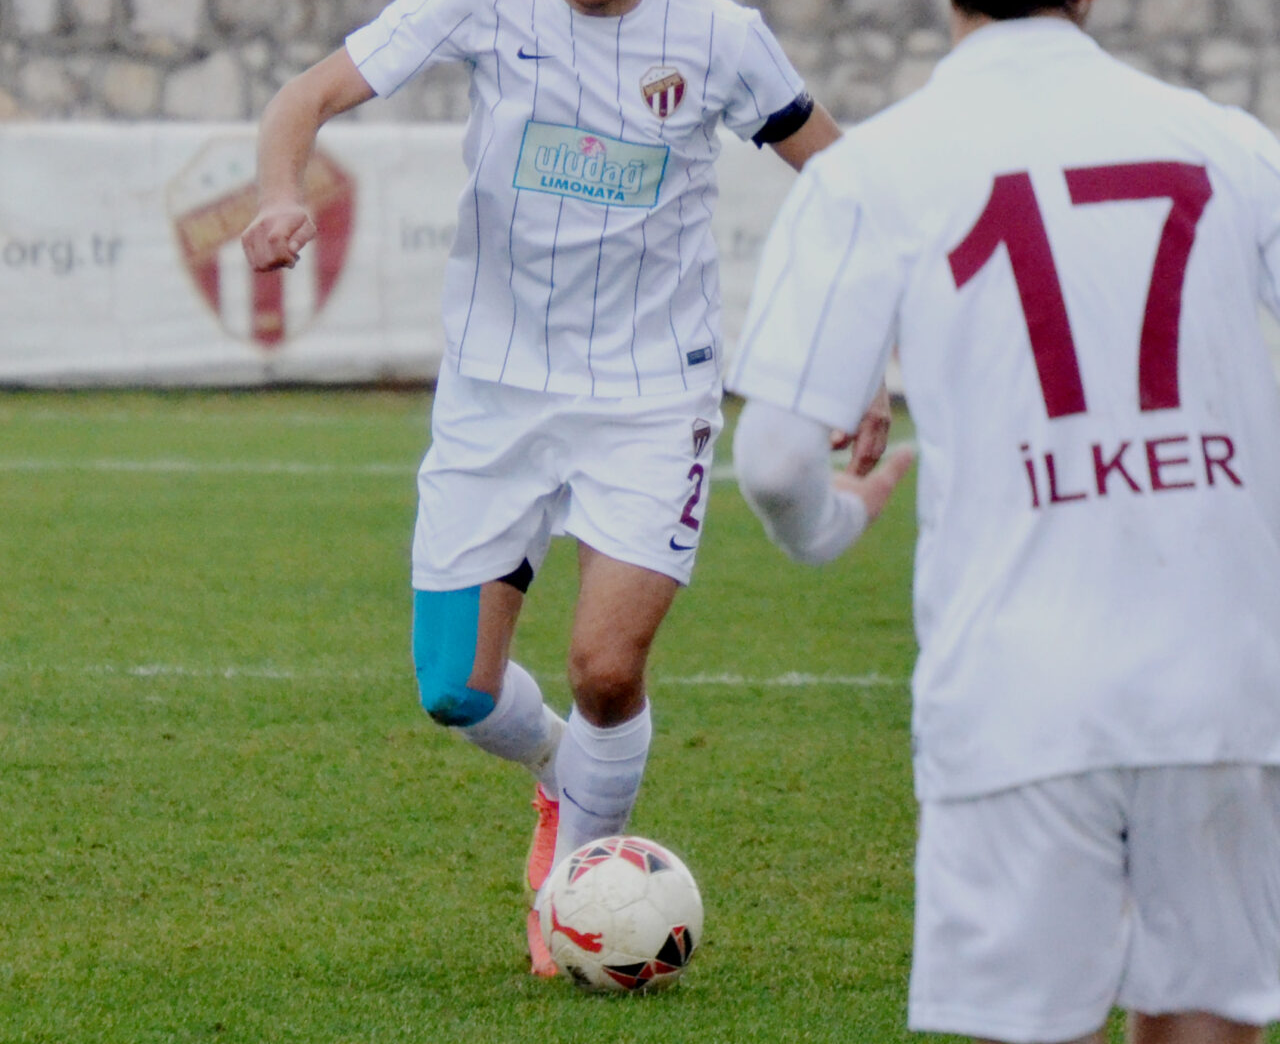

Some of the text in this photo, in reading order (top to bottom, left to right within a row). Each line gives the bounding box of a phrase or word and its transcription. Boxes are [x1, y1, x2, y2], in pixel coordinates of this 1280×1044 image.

[535, 144, 642, 193] uludağ
[541, 175, 625, 202] LIMONATA
[947, 161, 1212, 419] 17
[679, 463, 704, 531] 2
